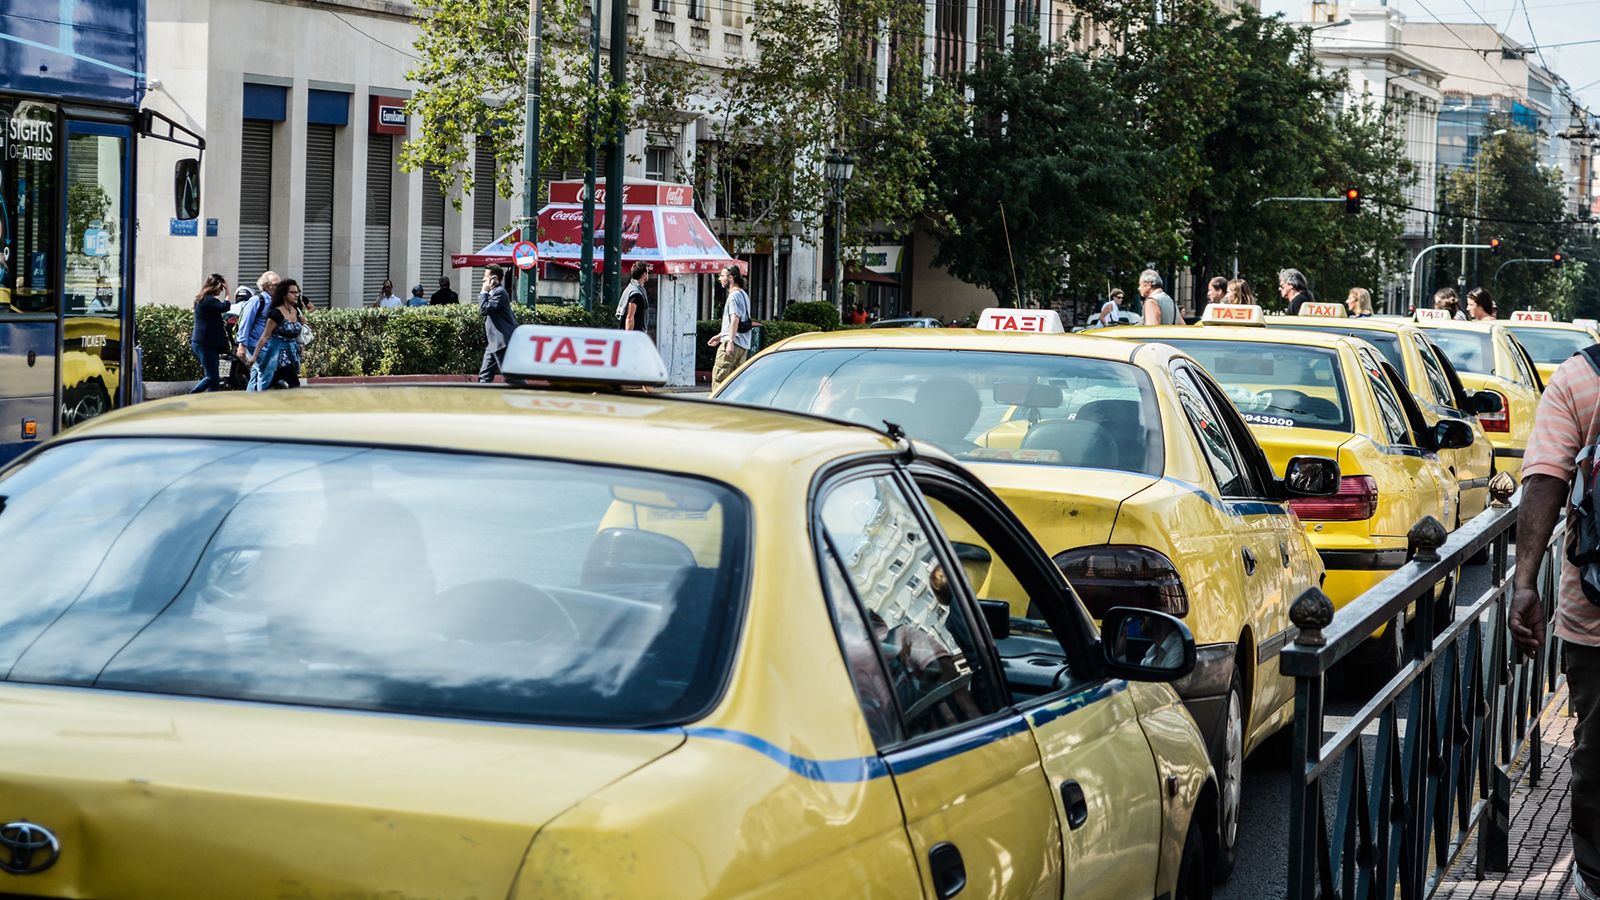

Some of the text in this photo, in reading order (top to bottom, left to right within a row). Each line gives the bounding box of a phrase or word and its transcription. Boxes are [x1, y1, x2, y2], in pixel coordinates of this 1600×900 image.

[9, 118, 53, 143] SIGHTS
[9, 143, 53, 162] OF ATHENS
[1214, 307, 1253, 320] ΤΑΞΙ
[1307, 305, 1336, 316] TAXI
[1421, 310, 1444, 319] ΤΑΞΙ
[1516, 313, 1547, 321] ΤΑΞΙ
[991, 315, 1044, 332] ΤΑΞΙ
[81, 335, 107, 347] TICKETS
[529, 336, 621, 367] ΤΑΞΙ
